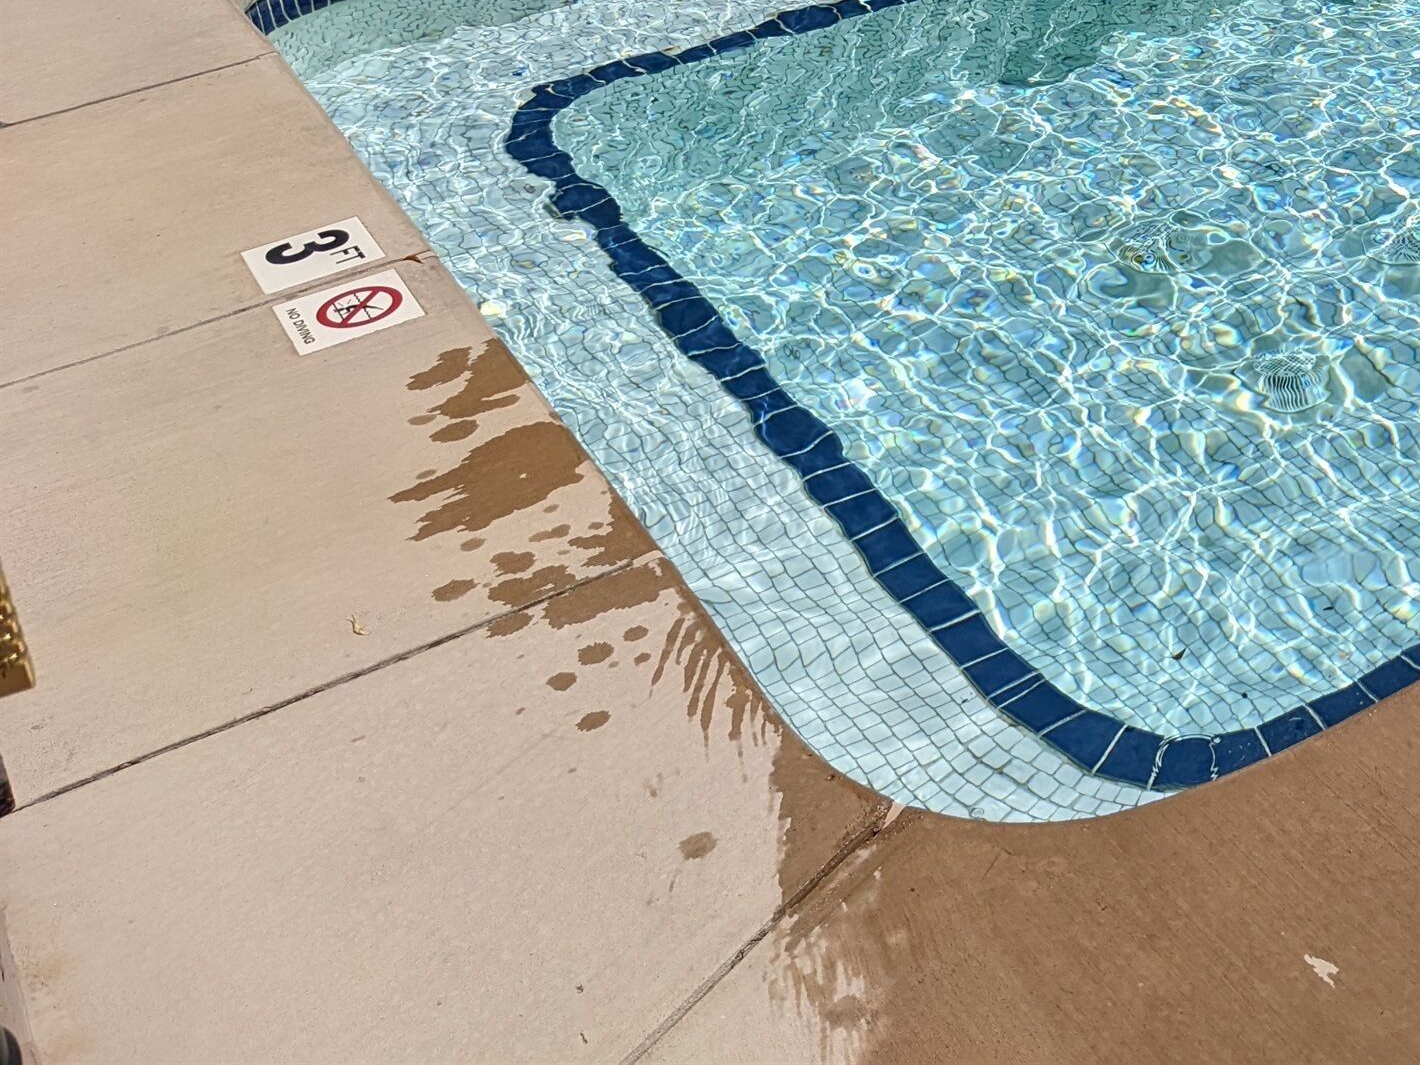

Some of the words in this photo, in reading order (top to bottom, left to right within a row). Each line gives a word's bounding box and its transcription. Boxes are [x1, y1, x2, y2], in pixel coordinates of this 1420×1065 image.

[265, 229, 350, 265] 3
[329, 245, 366, 265] FT
[285, 307, 301, 320] NO
[293, 319, 316, 345] DIVING
